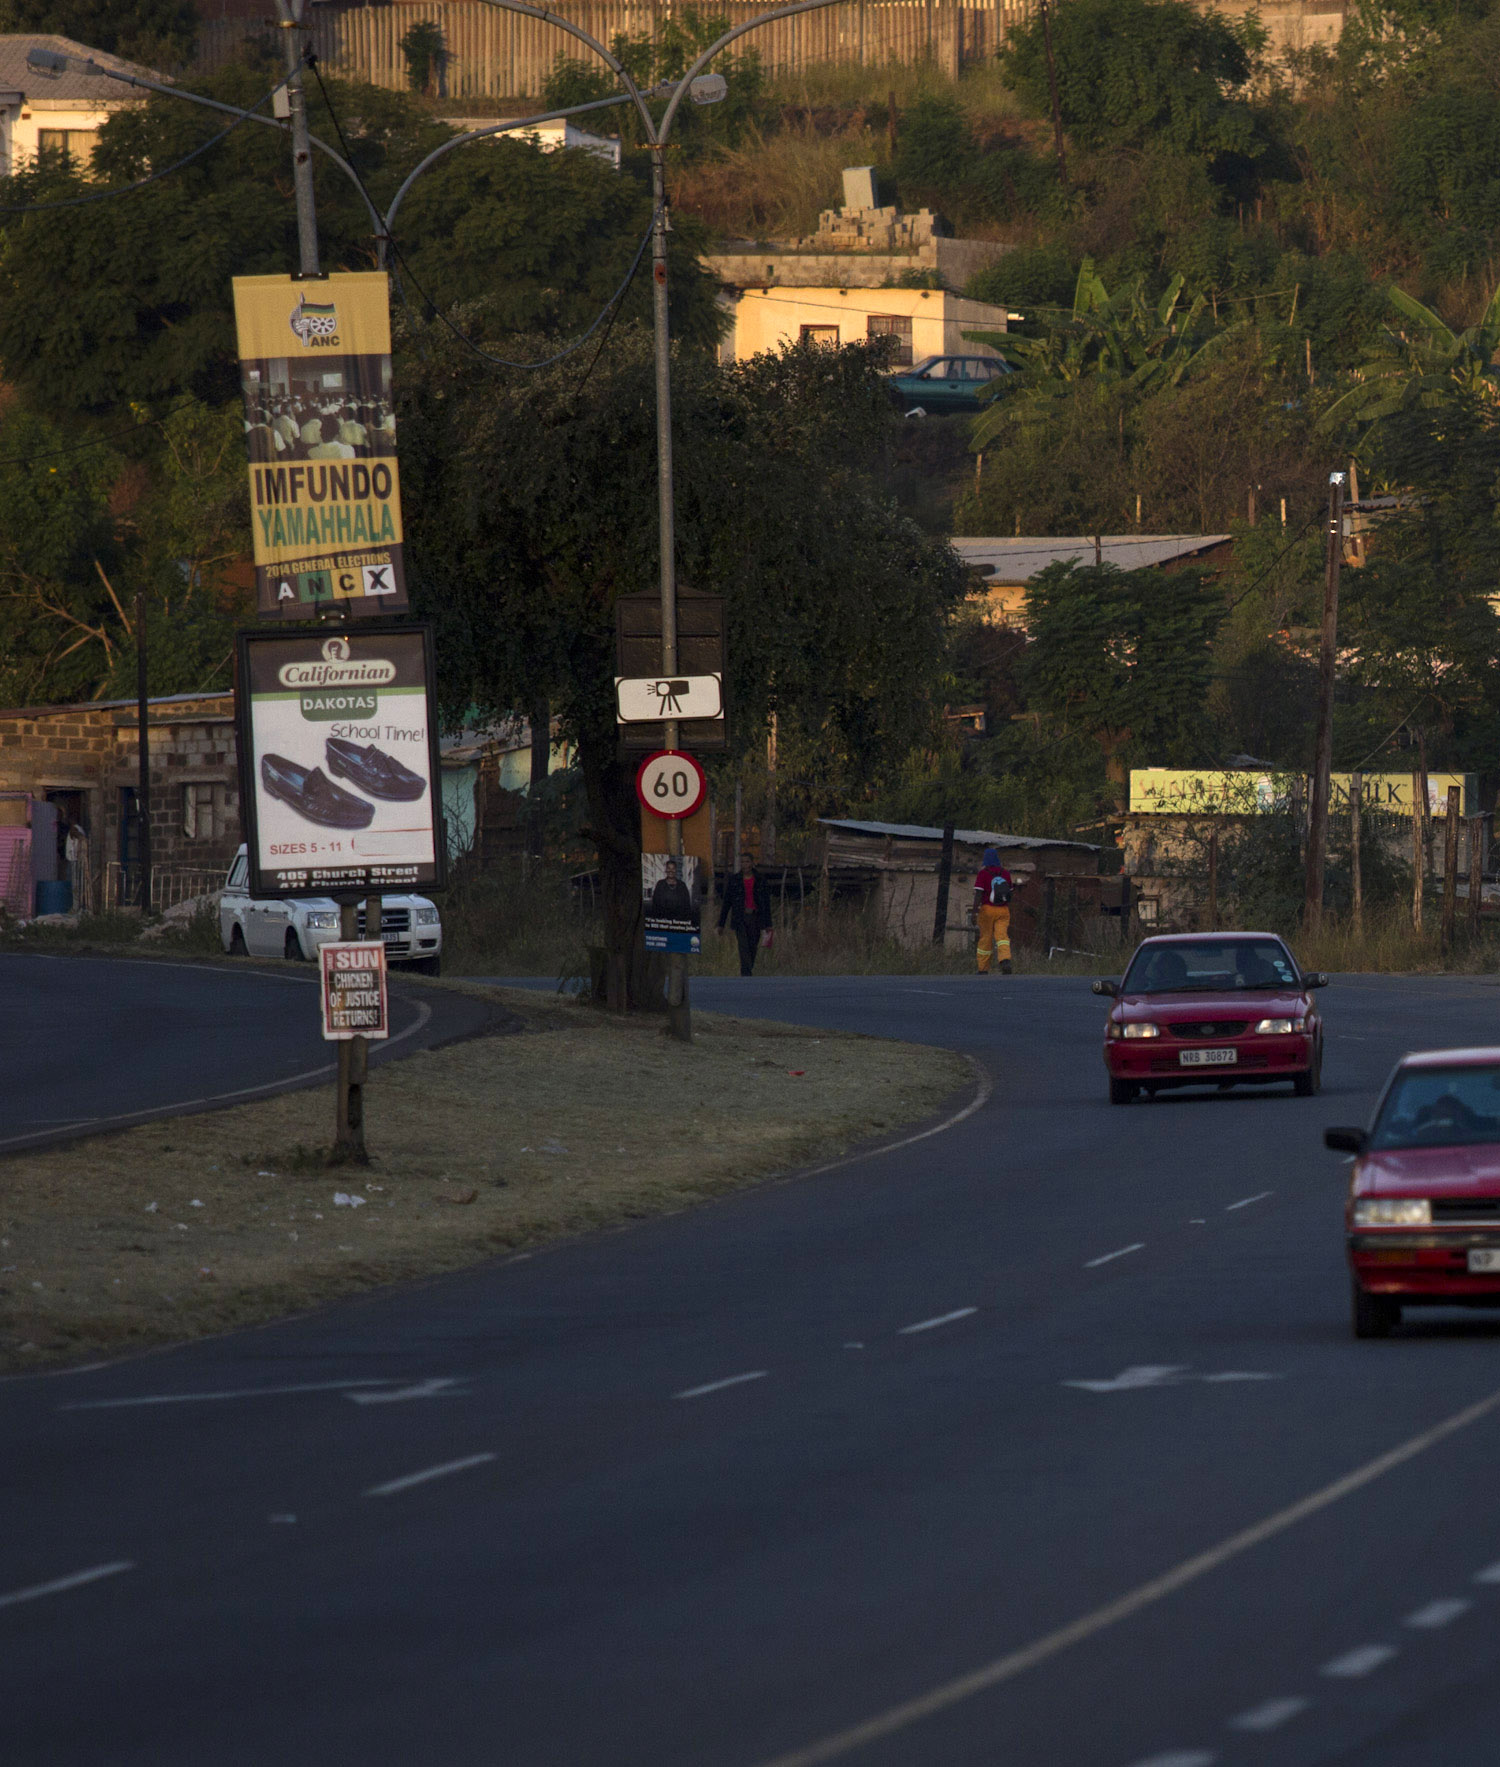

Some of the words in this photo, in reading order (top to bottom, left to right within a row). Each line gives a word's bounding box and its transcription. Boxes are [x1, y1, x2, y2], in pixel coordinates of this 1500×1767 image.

[310, 335, 340, 348] ANC
[255, 463, 393, 505] IMFUNDO
[258, 503, 396, 548] YAMAHHALA
[265, 563, 290, 578] 2014
[292, 557, 336, 575] GENERAL
[337, 551, 391, 570] ELECTIONS
[284, 664, 392, 686] Californian
[303, 696, 375, 711] DAKOTAS
[330, 723, 381, 740] School
[653, 771, 689, 798] 60
[270, 843, 307, 855] SIZES
[311, 842, 318, 853] 5
[330, 841, 342, 852] 11
[312, 868, 366, 879] Church
[371, 866, 418, 876] Street
[336, 950, 379, 968] SUN
[334, 972, 373, 988] CHICKEN
[330, 992, 342, 1008] OF
[345, 991, 380, 1008] JUSTICE
[333, 1010, 378, 1027] RETURNS!
[1182, 1051, 1200, 1063] NRB
